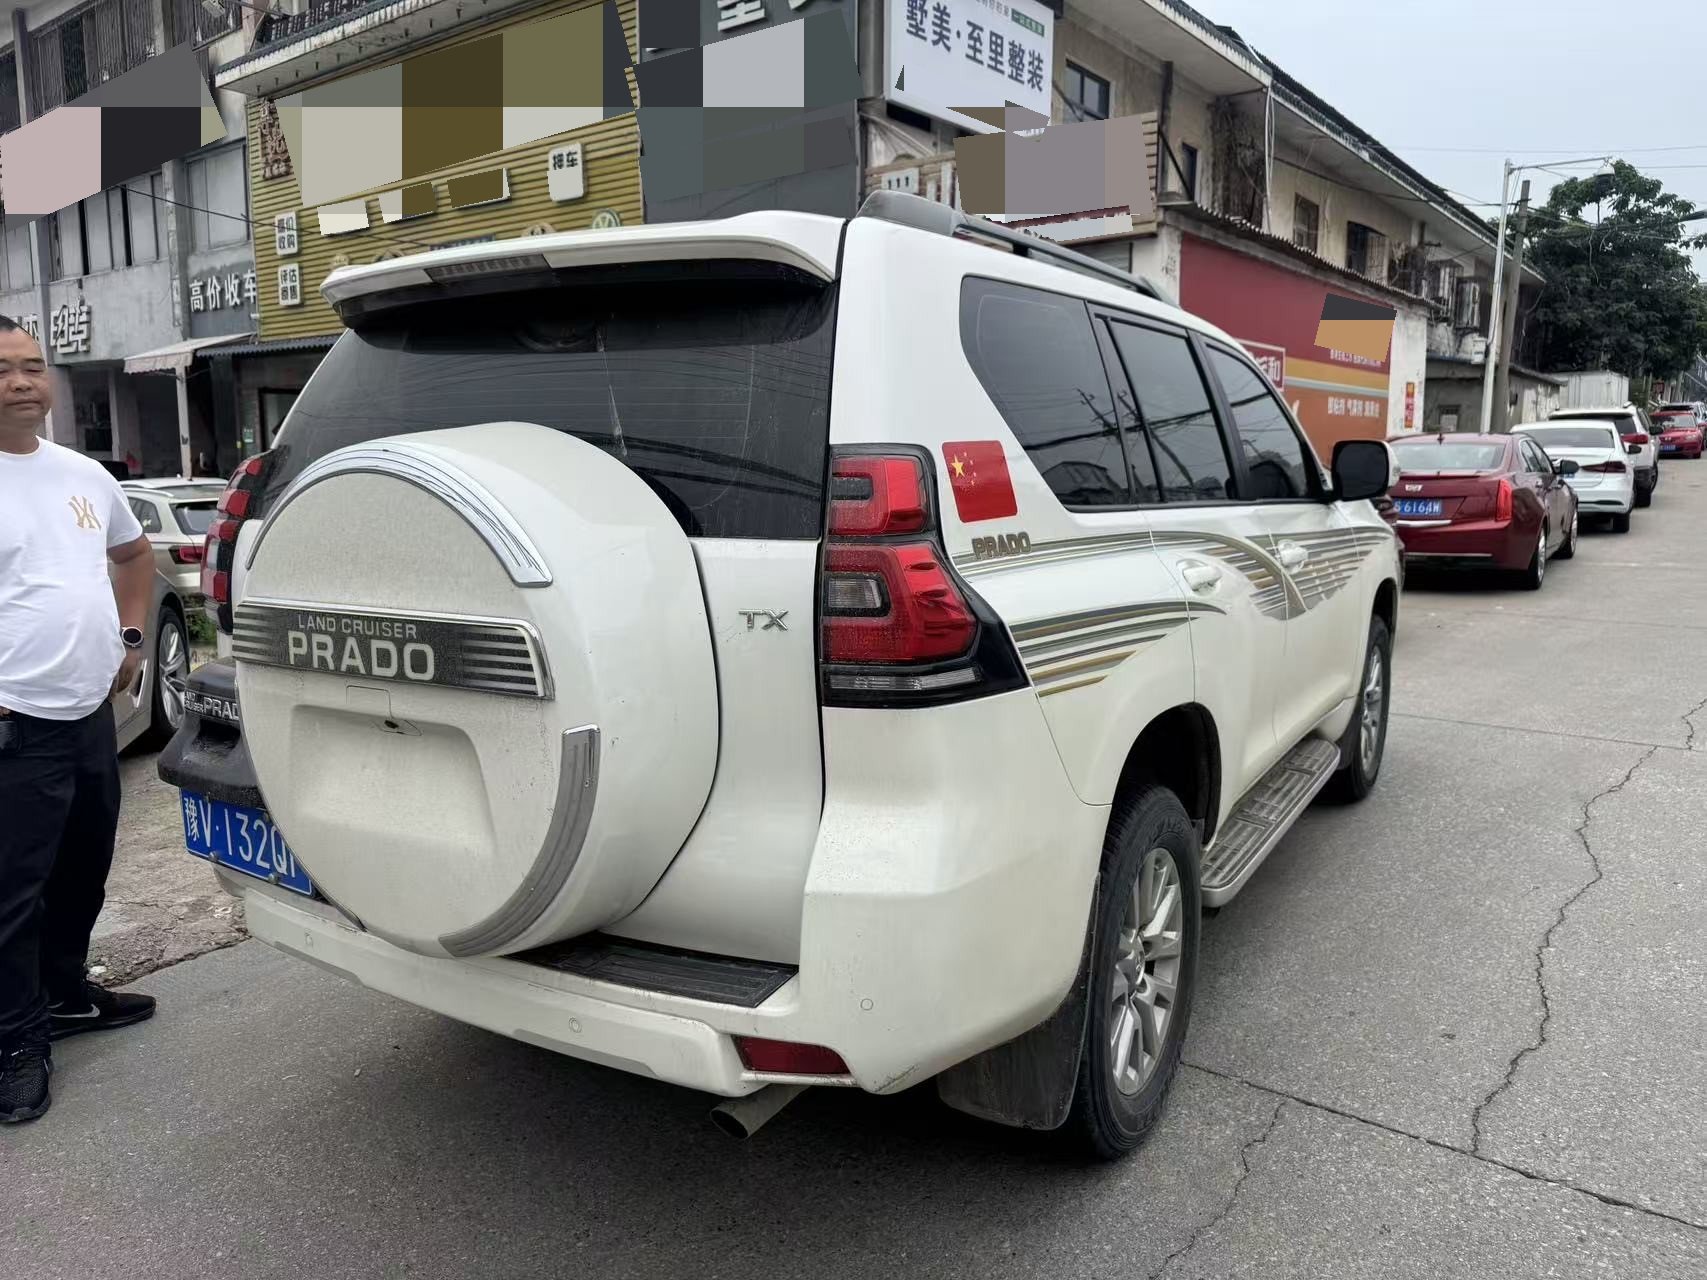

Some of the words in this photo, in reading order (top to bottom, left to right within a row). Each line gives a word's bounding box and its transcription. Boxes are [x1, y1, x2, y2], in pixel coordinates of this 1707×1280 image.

[189, 269, 257, 312] 高价收车
[972, 532, 1032, 560] PRADO
[298, 614, 336, 633] LAND
[341, 618, 417, 640] CRUISER
[738, 608, 789, 632] TX
[287, 630, 435, 682] PRADO
[203, 696, 240, 720] PRAD
[183, 797, 297, 878] 豫V·132Q
